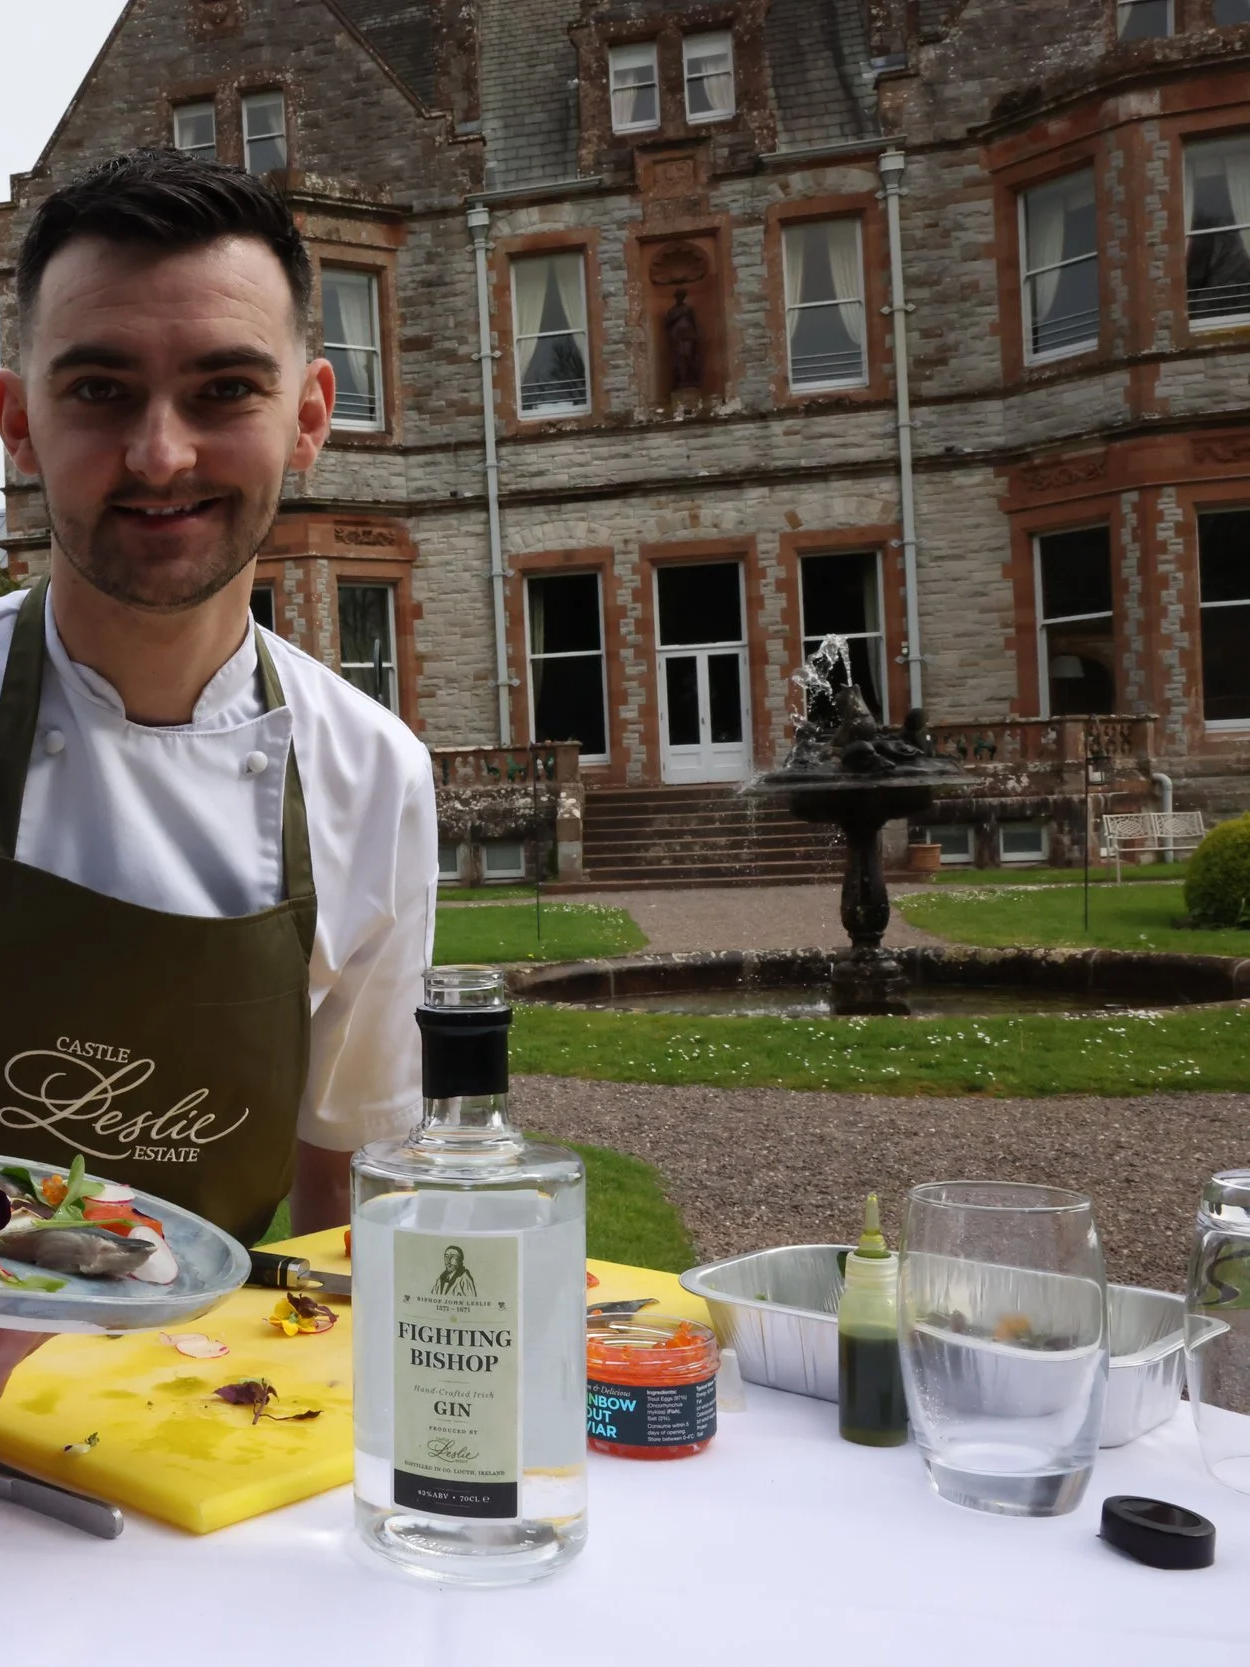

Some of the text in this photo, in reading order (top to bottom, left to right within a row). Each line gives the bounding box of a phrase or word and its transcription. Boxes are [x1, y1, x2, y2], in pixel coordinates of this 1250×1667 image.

[56, 1036, 131, 1063] CASTLE
[132, 1146, 200, 1162] ESTATE
[398, 1321, 512, 1348] FIGHTING
[410, 1348, 499, 1373] BISHOP
[413, 1384, 494, 1399] Hand-Crafted Irish
[433, 1400, 472, 1417] GIN
[586, 1391, 637, 1412] NBOW
[586, 1406, 612, 1423] OUT
[429, 1425, 467, 1435] PRODUCED
[427, 1439, 479, 1463] Leslie
[404, 1460, 432, 1471] DISTILLED
